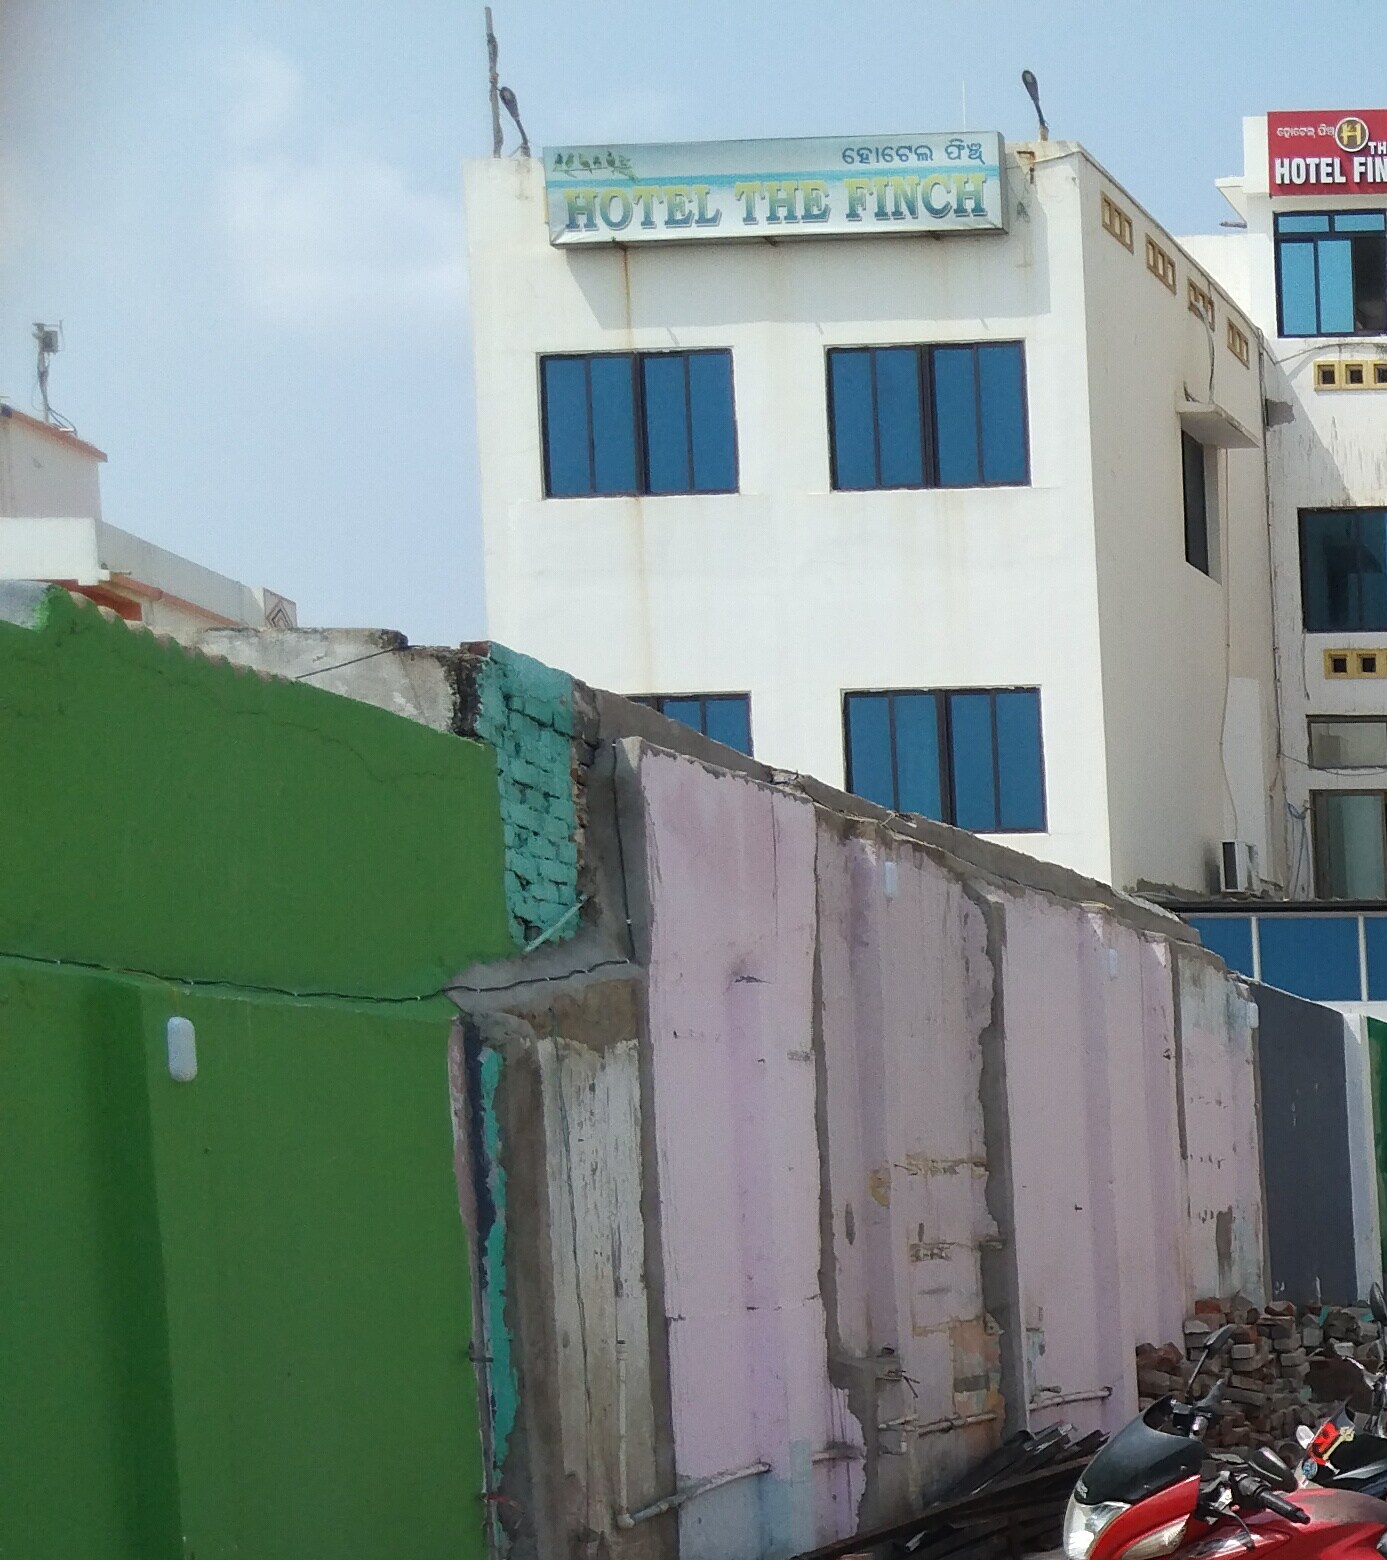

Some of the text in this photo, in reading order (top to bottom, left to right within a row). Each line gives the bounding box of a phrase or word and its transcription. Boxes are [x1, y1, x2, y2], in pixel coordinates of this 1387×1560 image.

[842, 144, 934, 165] ହୋଟେଲ
[1275, 157, 1347, 185] HOTEL
[562, 173, 989, 233] HOTEL THE FINCH
